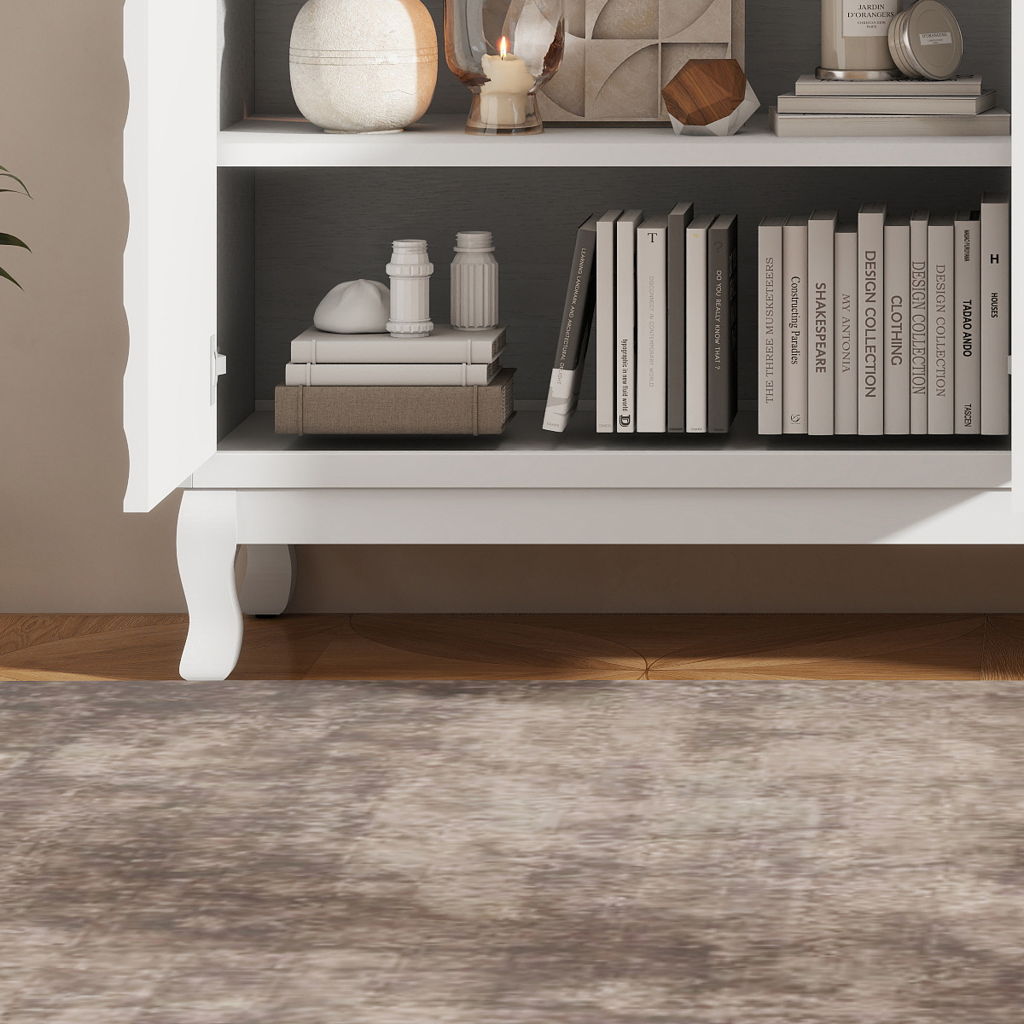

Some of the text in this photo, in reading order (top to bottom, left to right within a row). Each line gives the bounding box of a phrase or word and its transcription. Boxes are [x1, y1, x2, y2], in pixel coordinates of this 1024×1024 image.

[571, 276, 582, 305] LANDMARK
[714, 270, 722, 280] DO
[714, 282, 722, 296] YOU
[568, 306, 576, 319] AND
[714, 298, 722, 322] REALLY
[714, 324, 722, 345] KNOW
[766, 258, 774, 404] THE THREE MUSKETEERS
[790, 276, 801, 365] Constructing Paradies
[815, 282, 826, 373] SHAKESPEARE
[842, 294, 850, 373] MY ANTONIA
[865, 250, 877, 398] DESIGN COLLECTION
[890, 296, 902, 366] CLOTHING
[912, 261, 926, 395] DESIGN COLLECTION
[935, 264, 946, 398] DESIGN COLLECTION
[962, 299, 972, 358] TADAO ANDO
[990, 292, 998, 318] HOUSES
[714, 346, 722, 364] THAT
